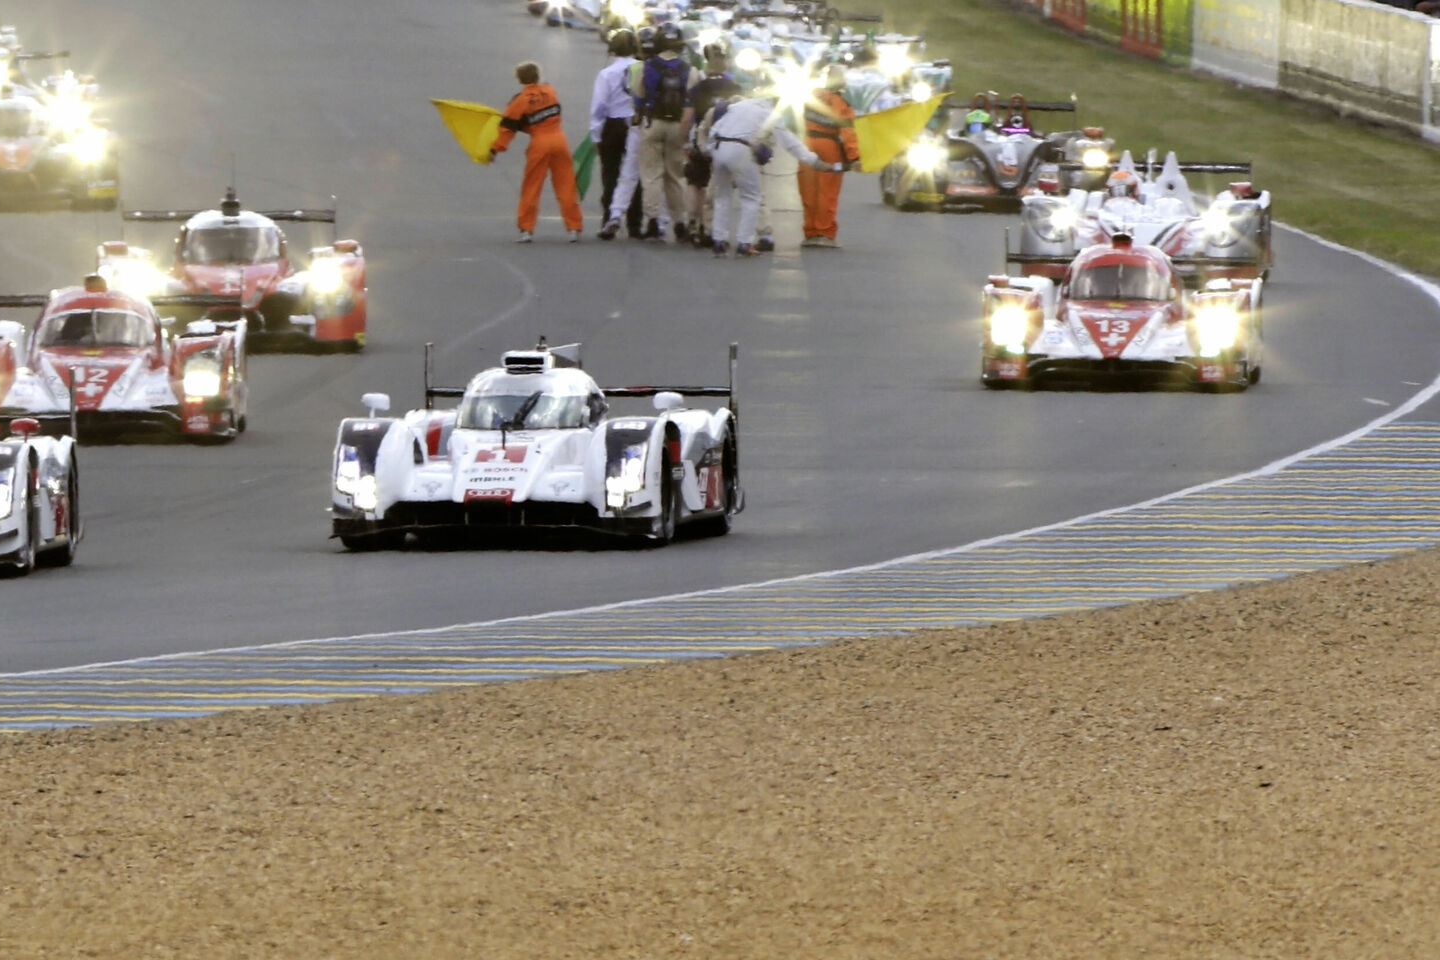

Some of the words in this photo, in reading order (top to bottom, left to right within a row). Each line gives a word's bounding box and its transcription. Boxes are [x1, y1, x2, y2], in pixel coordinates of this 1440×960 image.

[1095, 319, 1131, 333] 13
[74, 367, 109, 383] 12
[488, 449, 512, 463] 1
